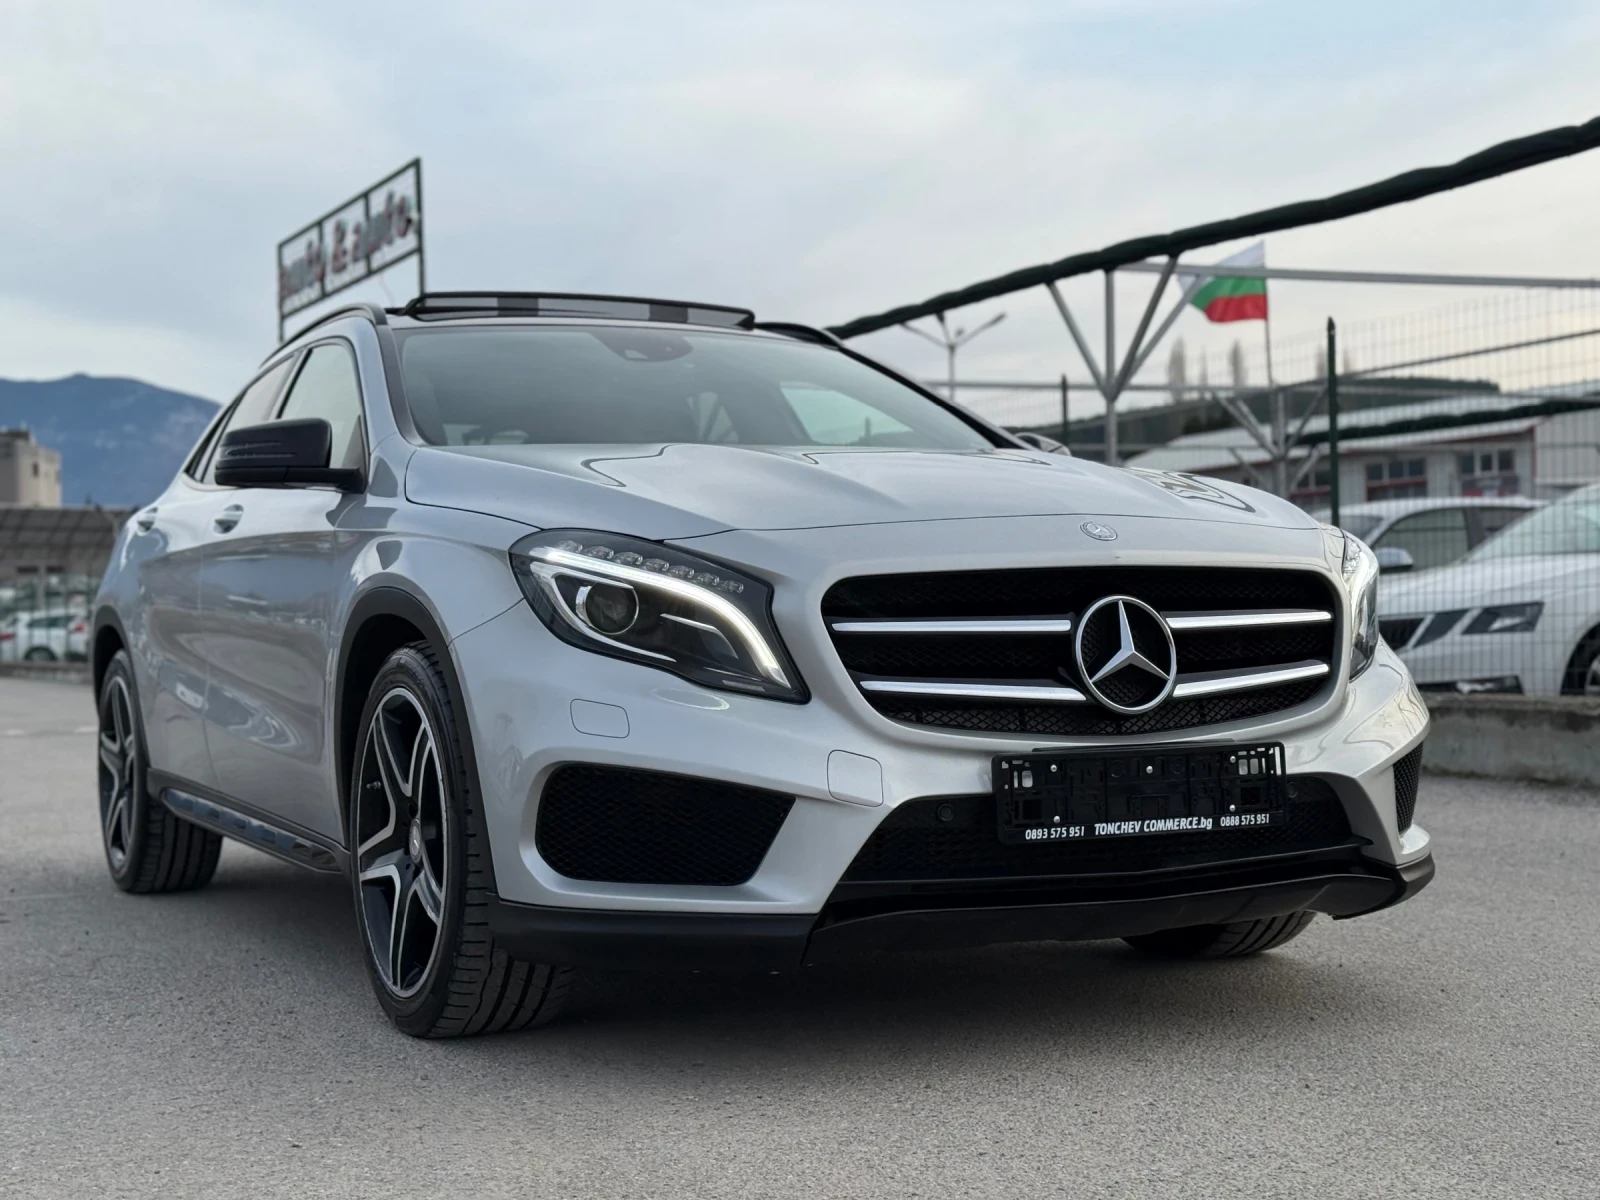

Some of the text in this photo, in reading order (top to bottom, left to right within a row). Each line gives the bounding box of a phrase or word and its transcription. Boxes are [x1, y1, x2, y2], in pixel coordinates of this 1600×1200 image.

[1025, 813, 1270, 840] 0893 575 951 TONCHEV COMMERCE.bg 0888 575 951
